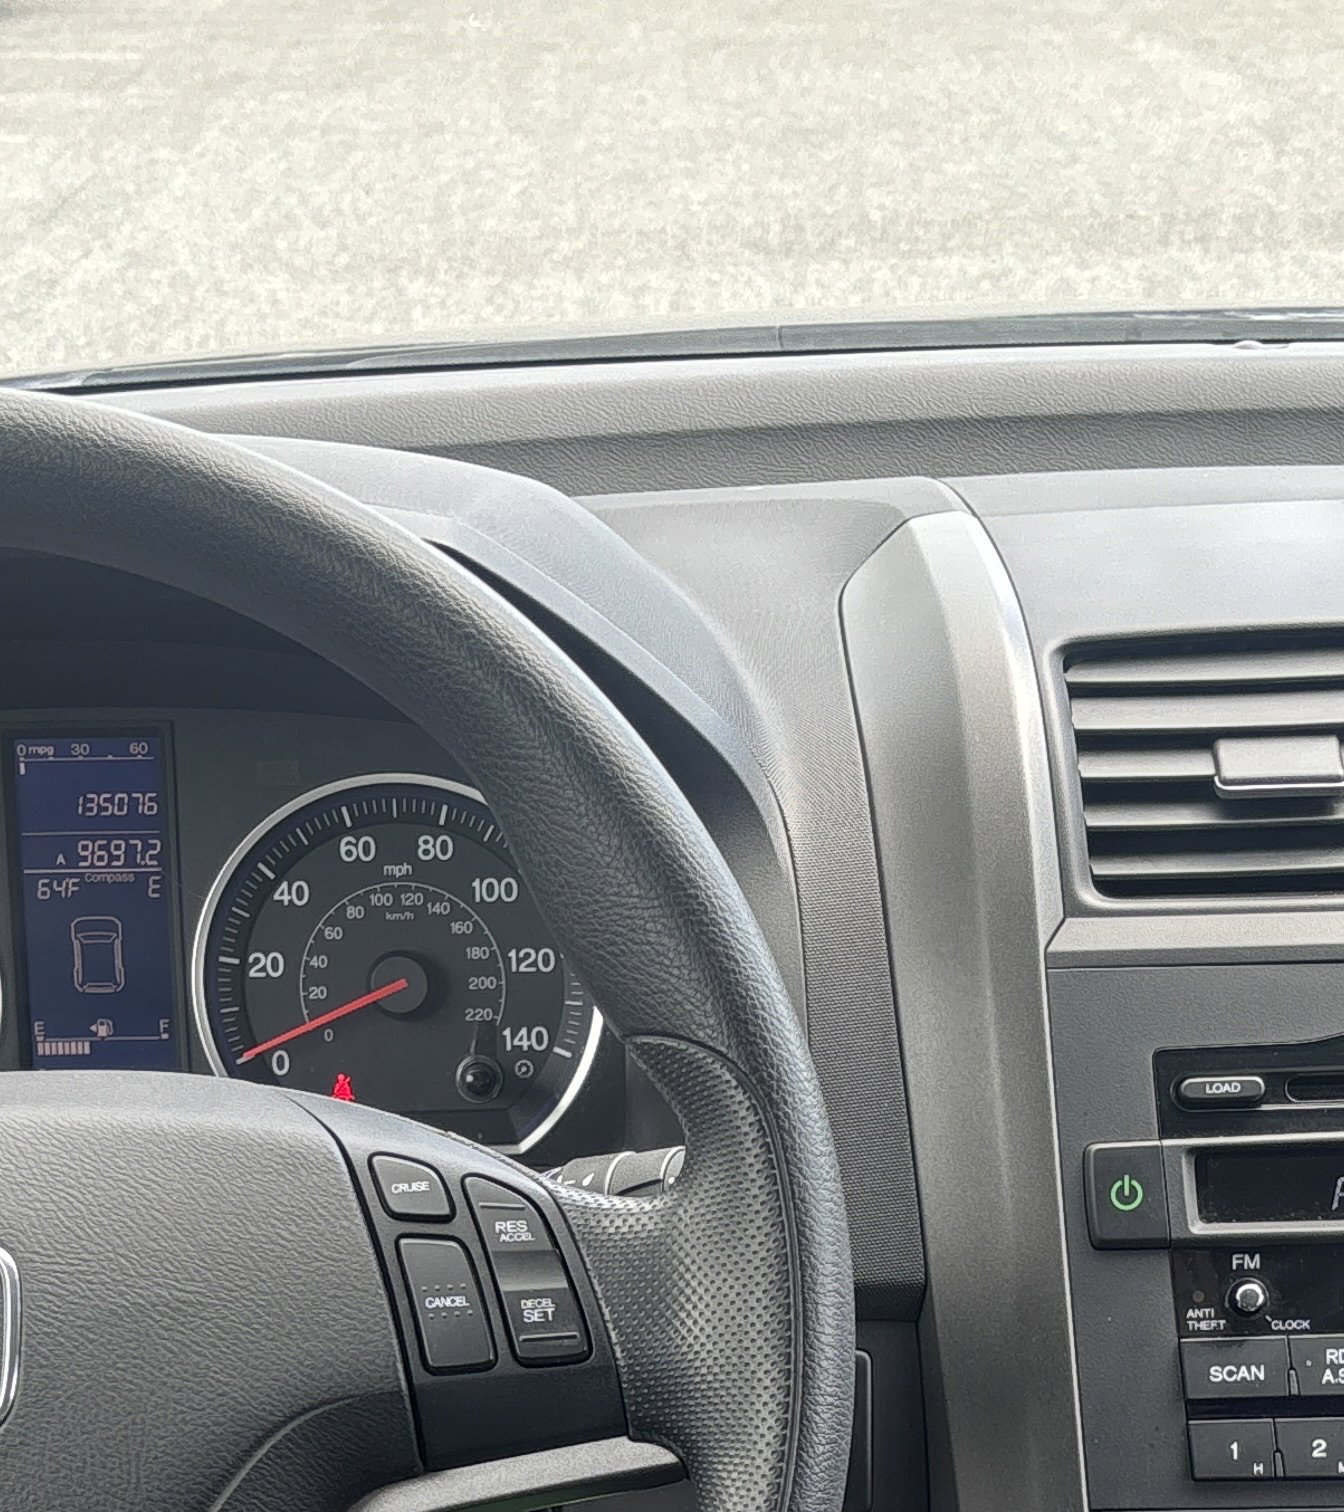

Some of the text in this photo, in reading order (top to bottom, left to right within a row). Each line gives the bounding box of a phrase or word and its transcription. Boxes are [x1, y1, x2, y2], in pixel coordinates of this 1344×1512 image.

[17, 743, 148, 757] 0 mpg 30 60
[78, 793, 158, 816] 135076
[56, 840, 161, 866] A 9697.2
[339, 836, 376, 862] 60
[417, 834, 453, 861] 80
[384, 863, 412, 878] mph
[85, 871, 135, 884] Compass
[148, 877, 161, 898] E
[472, 878, 518, 902] 100
[274, 881, 309, 906] 40
[369, 893, 393, 907] 100
[400, 892, 424, 906] 120
[346, 906, 364, 919] 80
[386, 910, 414, 921] km/h
[426, 902, 450, 916] 140
[325, 927, 343, 940] 60
[450, 921, 473, 934] 160
[466, 947, 489, 960] 180
[508, 948, 554, 973] 120
[248, 952, 284, 977] 20
[309, 956, 328, 968] 40
[469, 977, 497, 989] 200
[309, 986, 327, 999] 20
[465, 1008, 493, 1021] 220
[34, 1019, 170, 1035] E F
[324, 1029, 333, 1042] 0
[503, 1026, 549, 1051] 140
[272, 1050, 290, 1076] 0
[1205, 1082, 1241, 1094] LOAD
[391, 1182, 430, 1194] CRUISE
[494, 1221, 528, 1234] RES
[499, 1232, 536, 1243] ACCEL
[1232, 1254, 1260, 1270] FM
[425, 1296, 470, 1309] CANCEL
[520, 1298, 556, 1309] DECEL
[523, 1308, 555, 1322] SET
[1186, 1308, 1215, 1319] ANTI
[1187, 1320, 1226, 1331] THEFT
[1271, 1319, 1311, 1330] CLOCK
[1209, 1365, 1265, 1381] SCAN
[1230, 1442, 1238, 1460] 1
[1311, 1440, 1327, 1457] 2
[1253, 1463, 1264, 1475] H
